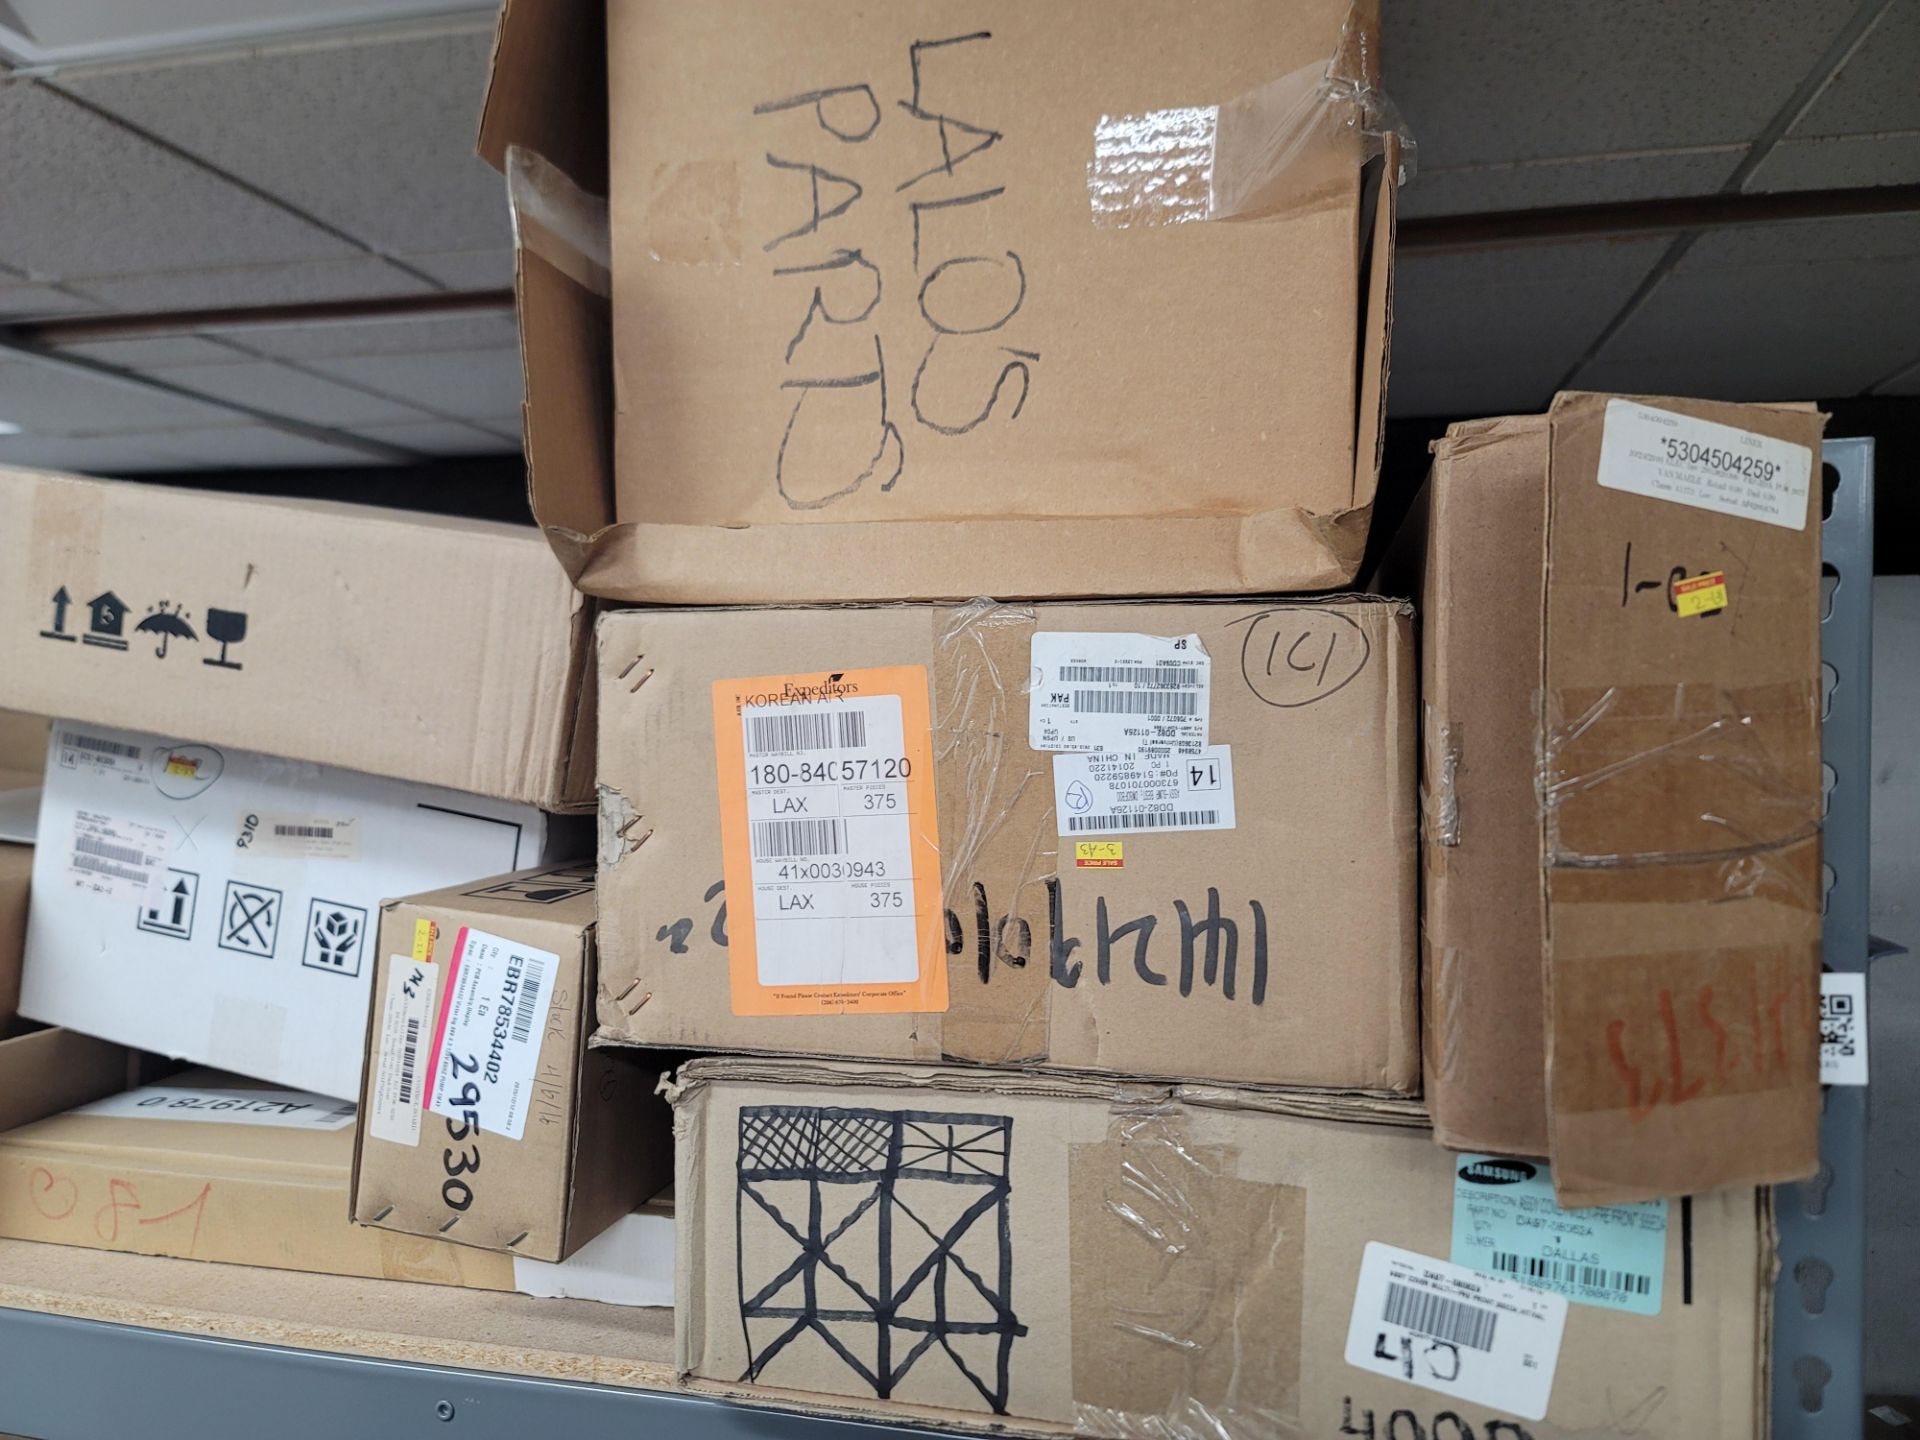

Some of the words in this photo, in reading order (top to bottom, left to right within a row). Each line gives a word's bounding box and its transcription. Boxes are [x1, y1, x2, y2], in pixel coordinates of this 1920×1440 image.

[896, 31, 1041, 437] LALO'S
[754, 83, 907, 511] PARTS
[1174, 639, 1186, 649] SP
[783, 672, 858, 699] Expeditors
[744, 690, 812, 708] KOREAN
[1050, 692, 1069, 702] PAK
[1086, 753, 1118, 763] CHINA
[1124, 752, 1135, 760] IN
[1189, 764, 1216, 785] 14
[772, 796, 808, 813] LAX
[863, 792, 896, 809] 375
[779, 894, 814, 910] LAX
[870, 891, 903, 908] 375
[490, 946, 499, 958] Qty
[477, 1004, 488, 1017] Ea
[482, 953, 523, 1085] EBR78534402
[441, 1052, 482, 1213] 29530
[1465, 1162, 1528, 1182] SAMSUNG
[1541, 1244, 1601, 1265] DALLAS
